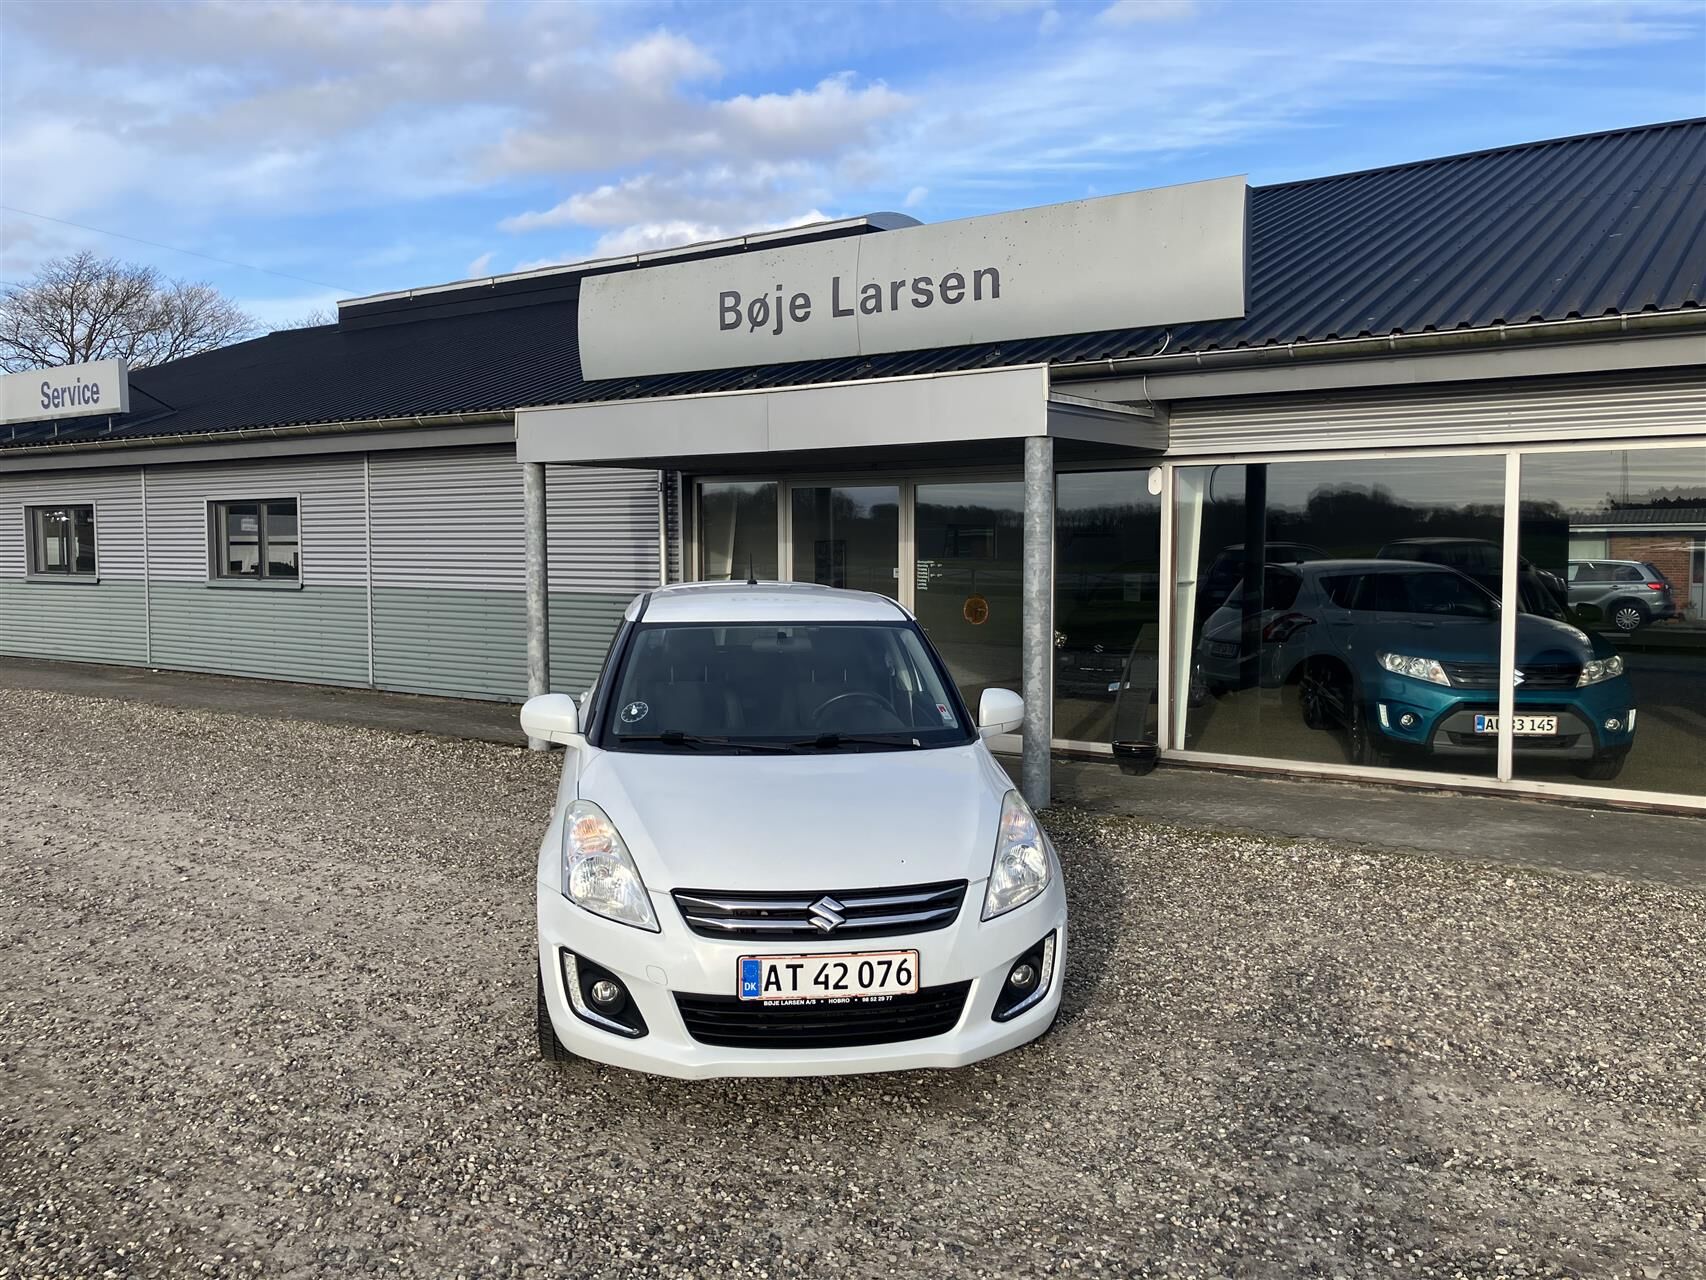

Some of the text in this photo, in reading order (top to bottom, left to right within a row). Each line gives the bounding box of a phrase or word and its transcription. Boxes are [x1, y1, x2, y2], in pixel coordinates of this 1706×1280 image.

[719, 267, 1001, 336] Bøje Larsen
[41, 377, 100, 409] Service
[1530, 719, 1553, 731] 145
[744, 982, 757, 991] DK
[763, 958, 912, 992] AT 42 076
